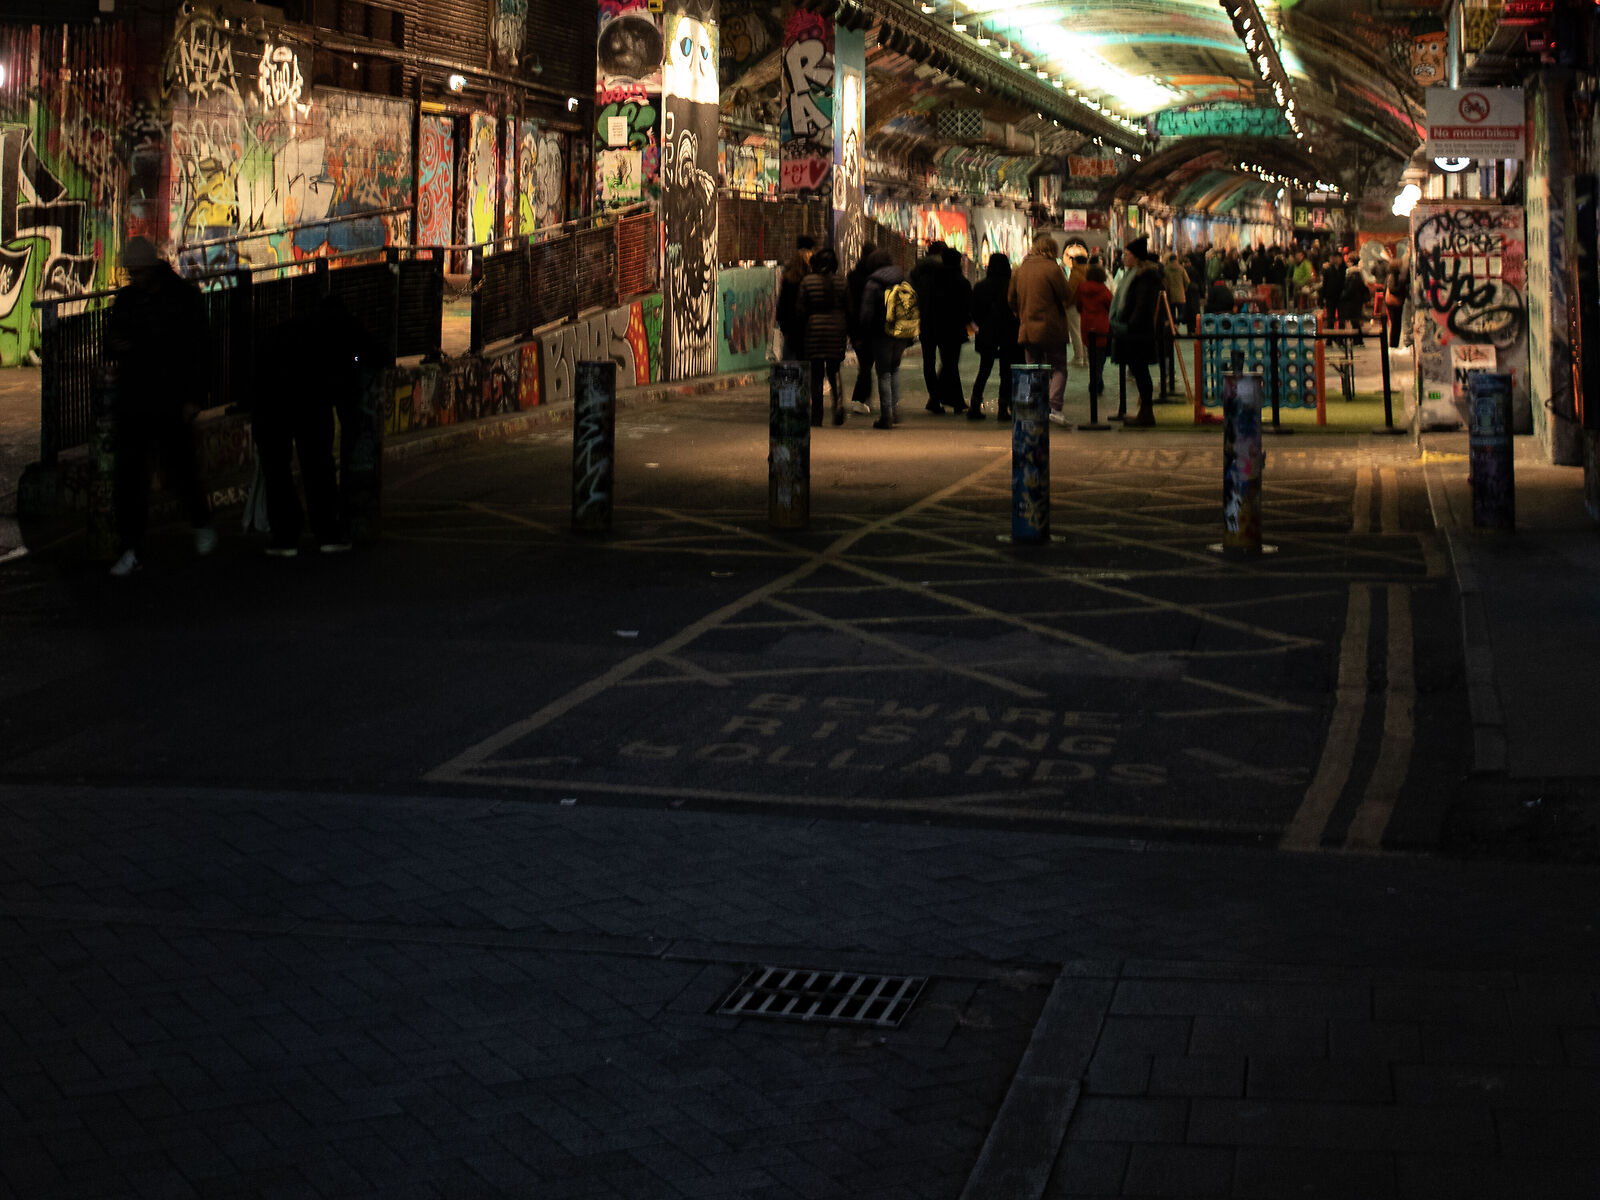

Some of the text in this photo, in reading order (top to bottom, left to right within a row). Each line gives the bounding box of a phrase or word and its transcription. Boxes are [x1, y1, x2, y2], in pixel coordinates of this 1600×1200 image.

[1433, 126, 1516, 138] No motorbikes
[746, 691, 1121, 730] BEWARE
[720, 713, 1119, 756] RISING
[617, 738, 1170, 785] BOLLARDS
